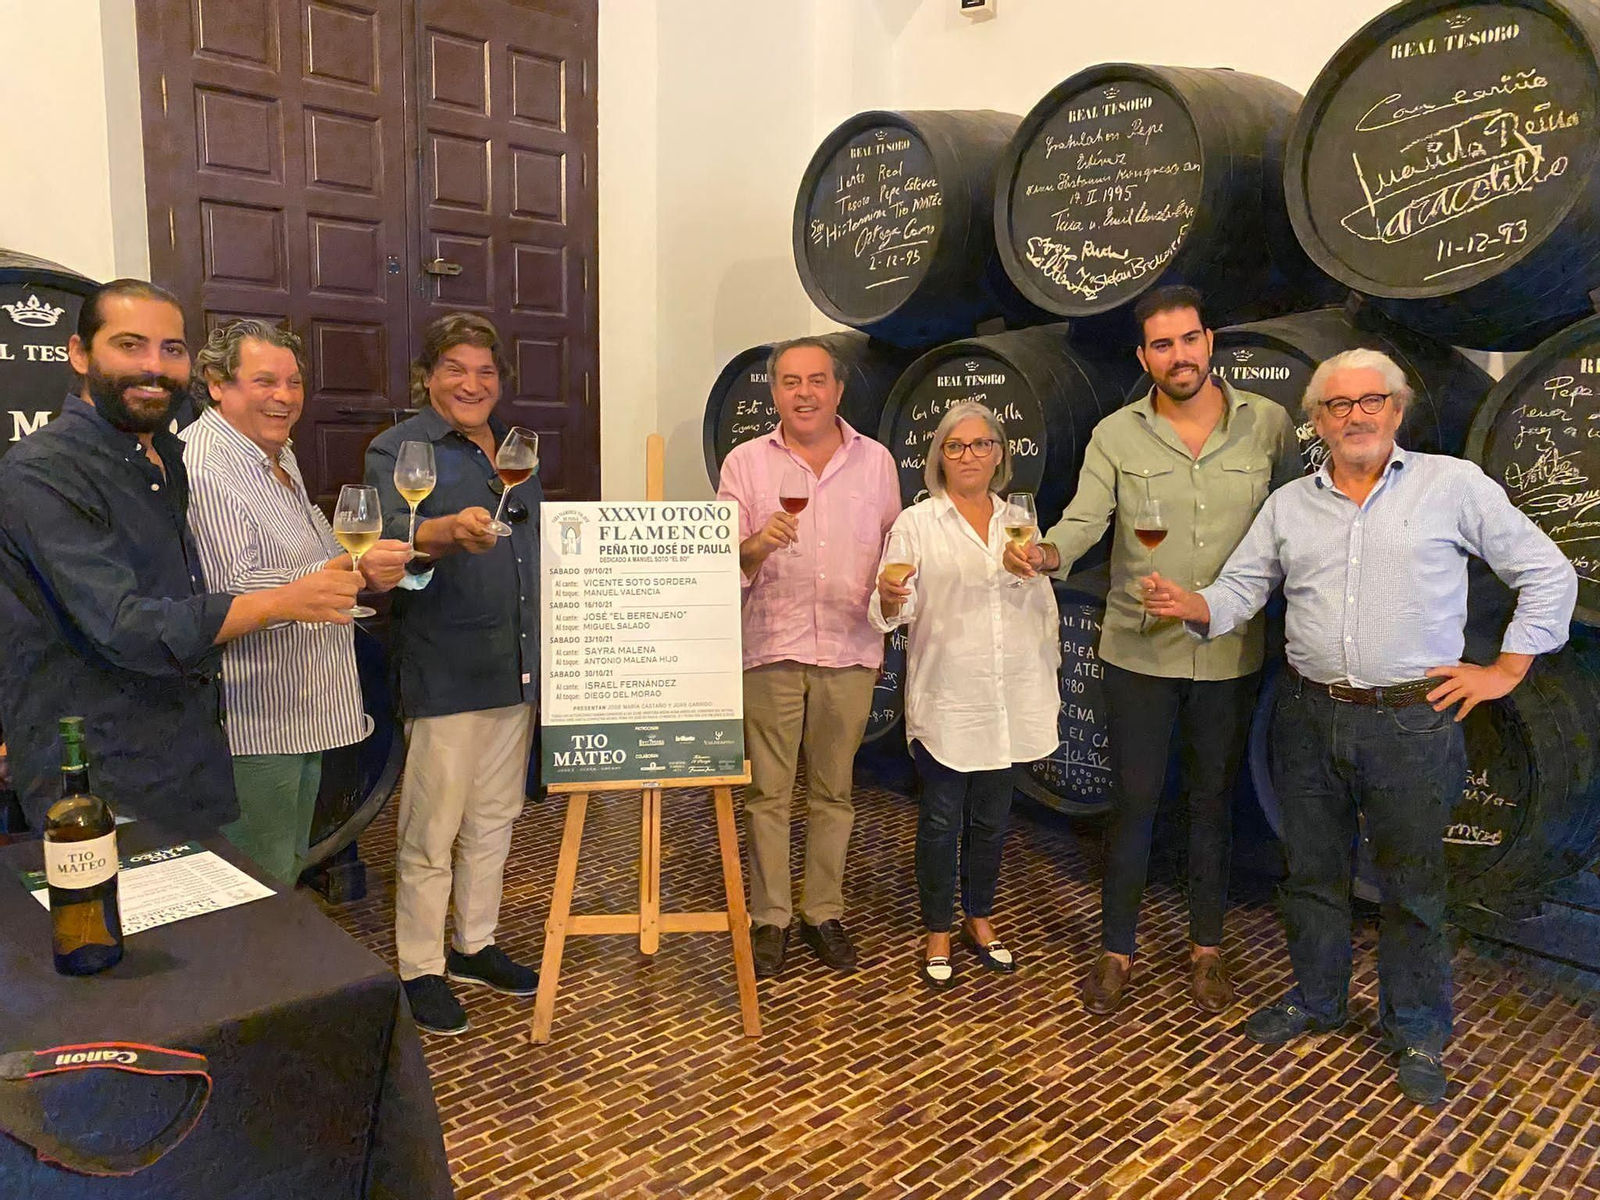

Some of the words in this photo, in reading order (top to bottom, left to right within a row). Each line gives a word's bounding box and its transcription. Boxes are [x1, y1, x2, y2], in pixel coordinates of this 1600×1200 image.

[1391, 41, 1437, 60] REAL
[1443, 24, 1520, 51] TESORO
[1068, 106, 1098, 123] REAL
[1102, 96, 1153, 118] TESORO
[850, 146, 873, 159] REAL
[875, 139, 910, 157] TESORO
[1103, 184, 1138, 203] 1995
[1436, 219, 1528, 263] 11-12-93
[23, 344, 69, 362] TES
[1231, 365, 1291, 380] TESORO
[937, 375, 963, 388] REAL
[965, 373, 1006, 386] TESORO
[598, 506, 656, 522] XXXVI
[661, 503, 732, 522] OTOÑO
[599, 525, 731, 541] FLAMENCO
[599, 543, 629, 556] PEÑA
[630, 544, 649, 555] TIO
[650, 542, 679, 556] JOSÉ
[680, 544, 695, 555] DE
[697, 543, 732, 555] PAULA
[549, 567, 580, 575] SABADO
[583, 567, 613, 575] 09/10/21
[583, 579, 625, 587] VICENTE
[625, 578, 651, 587] SOTO
[653, 577, 698, 586] SORDERA
[583, 589, 619, 597] MANUEL
[620, 588, 661, 596] VALENCIA
[549, 601, 580, 609] SABADO
[616, 622, 651, 630] SALADO
[549, 636, 580, 644] SABADO
[584, 636, 613, 644] 23/10/21
[584, 647, 616, 656] SAYRA
[618, 646, 657, 655] MALENA
[584, 657, 622, 665] ANTONIO
[623, 656, 658, 664] MALENA
[659, 655, 679, 663] HIJO
[549, 670, 581, 678] SABADO
[584, 681, 619, 690] ISRAEL
[620, 678, 677, 688] FERNÁNDEZ
[584, 692, 611, 700] DIEGO
[612, 691, 629, 699] DEL
[631, 690, 662, 698] MORAO
[571, 733, 608, 750] TIO
[553, 749, 627, 767] MATEO
[67, 851, 94, 862] TIO
[57, 858, 106, 873] MATEO
[54, 1050, 138, 1066] Canon
